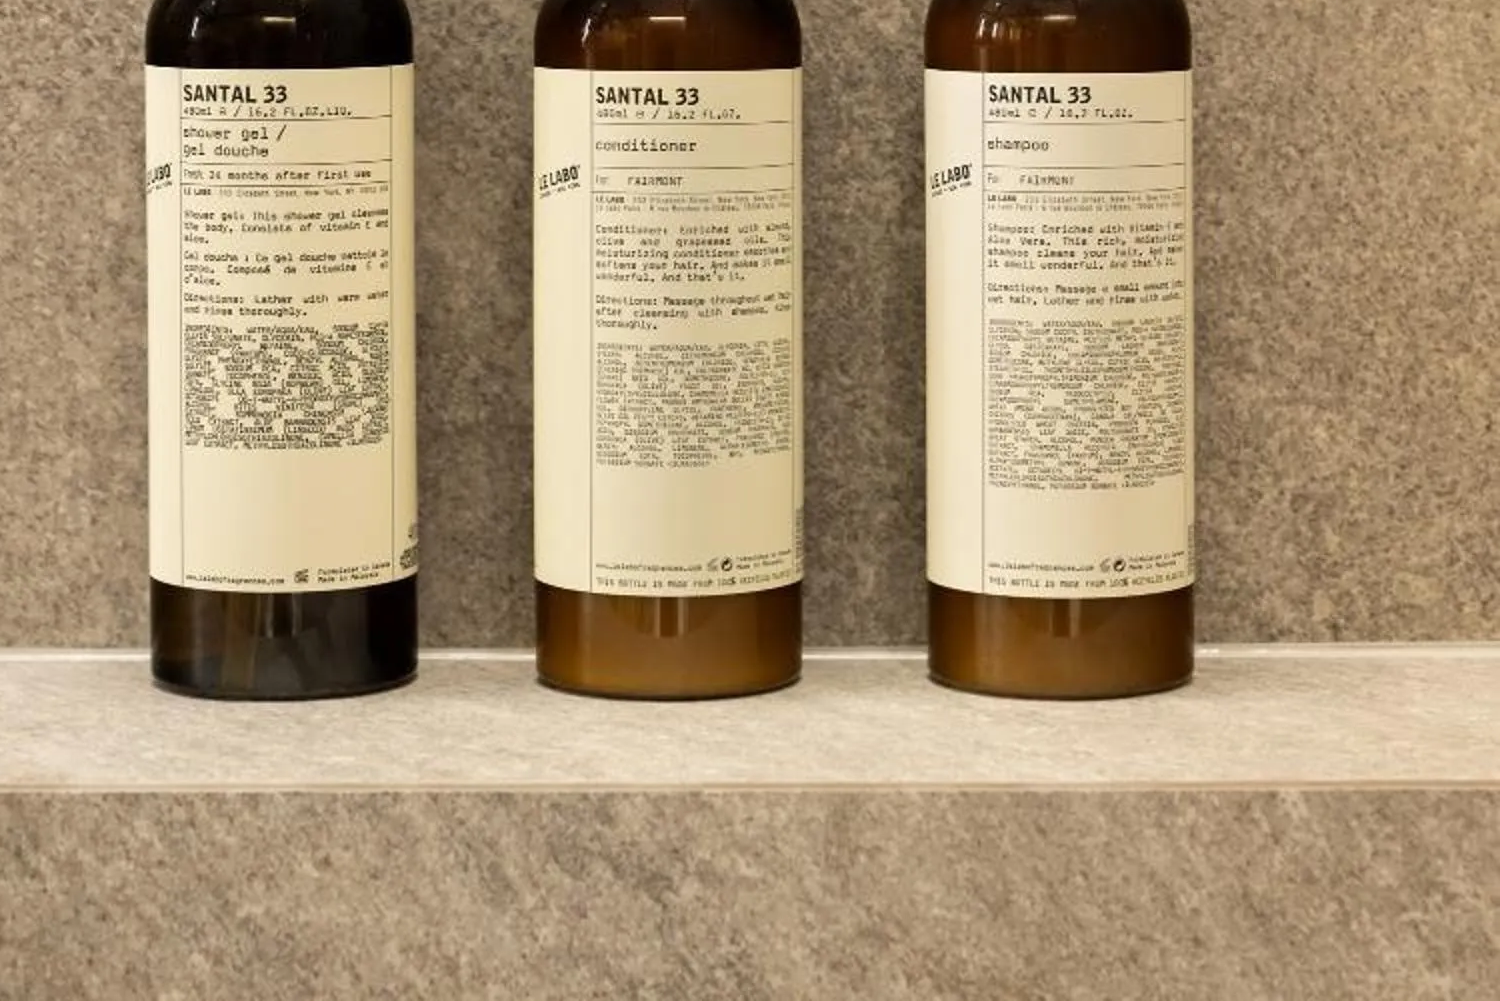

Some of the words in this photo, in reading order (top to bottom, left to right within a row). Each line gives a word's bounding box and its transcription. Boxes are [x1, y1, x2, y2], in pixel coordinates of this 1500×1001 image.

[183, 85, 257, 103] SANTAL
[263, 85, 287, 103] 33
[596, 86, 669, 105] SANTAL
[675, 88, 699, 105] 33
[989, 85, 1062, 104] SANTAL
[1067, 86, 1092, 104] 33
[183, 127, 231, 140] shower
[241, 127, 269, 142] gel
[276, 124, 287, 141] /
[596, 138, 697, 152] conditioner
[987, 137, 1049, 152] shampoo
[183, 144, 205, 157] gel
[214, 144, 269, 157] douche
[228, 170, 268, 180] months
[276, 170, 310, 180] after
[317, 169, 348, 180] first
[549, 164, 580, 186] LABO
[942, 164, 971, 186] LABO
[628, 176, 684, 186] FAIRMONT
[1020, 175, 1075, 186] FAIRMONT
[300, 222, 312, 232] of
[1100, 224, 1124, 234] with
[1063, 237, 1087, 246] This
[1083, 250, 1108, 259] your
[1040, 260, 1103, 270] wonderful.
[661, 272, 681, 282] And
[303, 294, 328, 304] with
[239, 306, 307, 318] thoroughly.
[596, 319, 657, 330] thoroughly.
